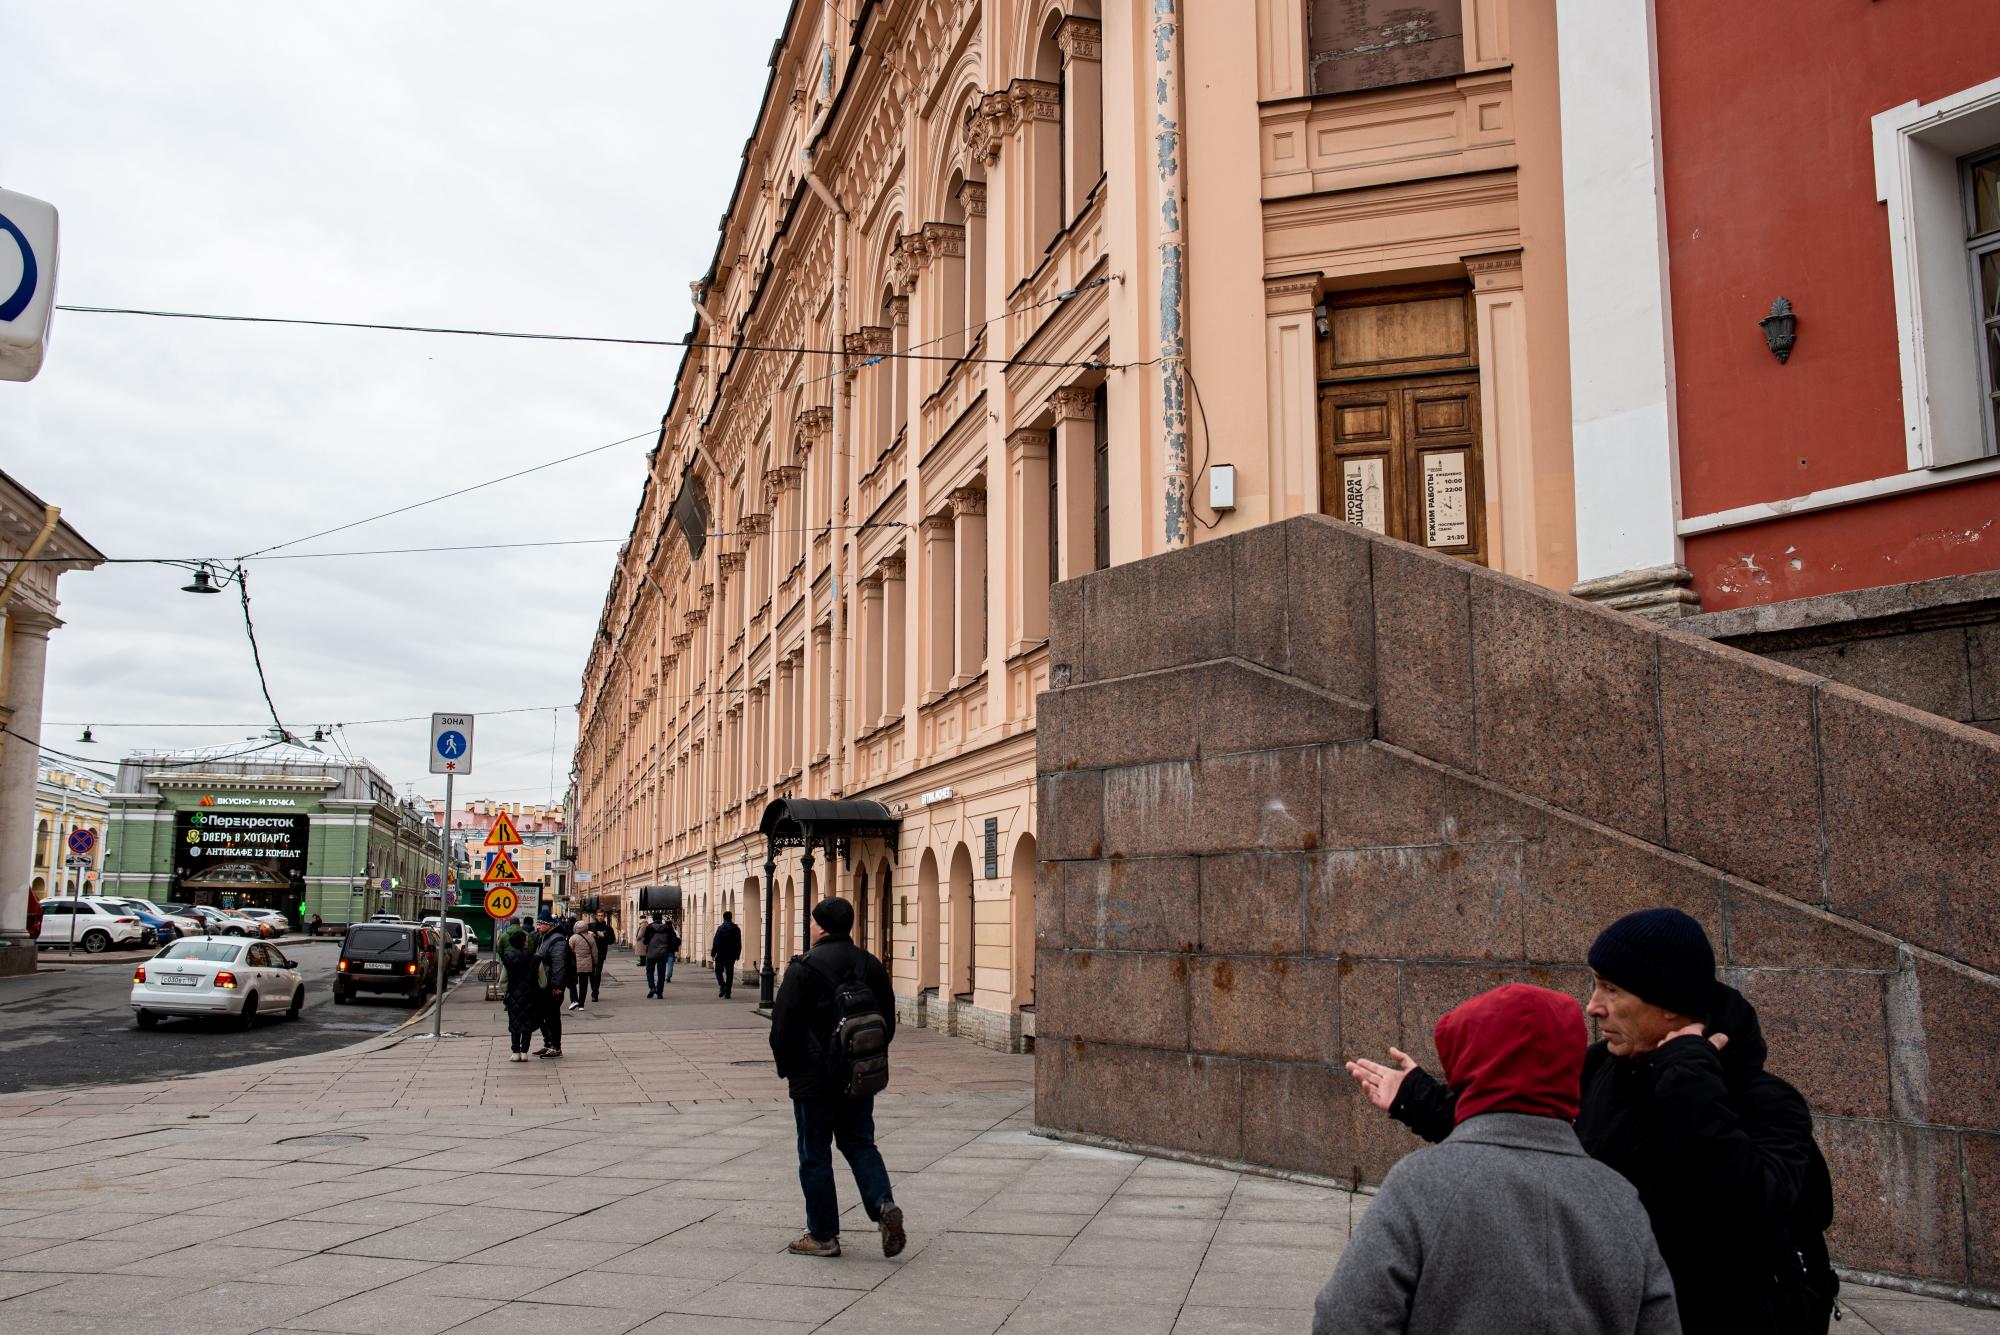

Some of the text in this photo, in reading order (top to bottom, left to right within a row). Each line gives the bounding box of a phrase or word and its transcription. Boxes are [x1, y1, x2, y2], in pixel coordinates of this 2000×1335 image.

[1427, 473, 1435, 508] РАБОТЫ
[1428, 510, 1436, 541] РЕЖИМ
[441, 717, 464, 725] ЗОНА
[217, 797, 251, 806] ВКУСНО
[208, 814, 294, 828] Перекресток
[235, 833, 240, 842] В
[205, 847, 301, 858] АНТИКАФЕ 12 КОМНАТ
[491, 896, 512, 909] 40
